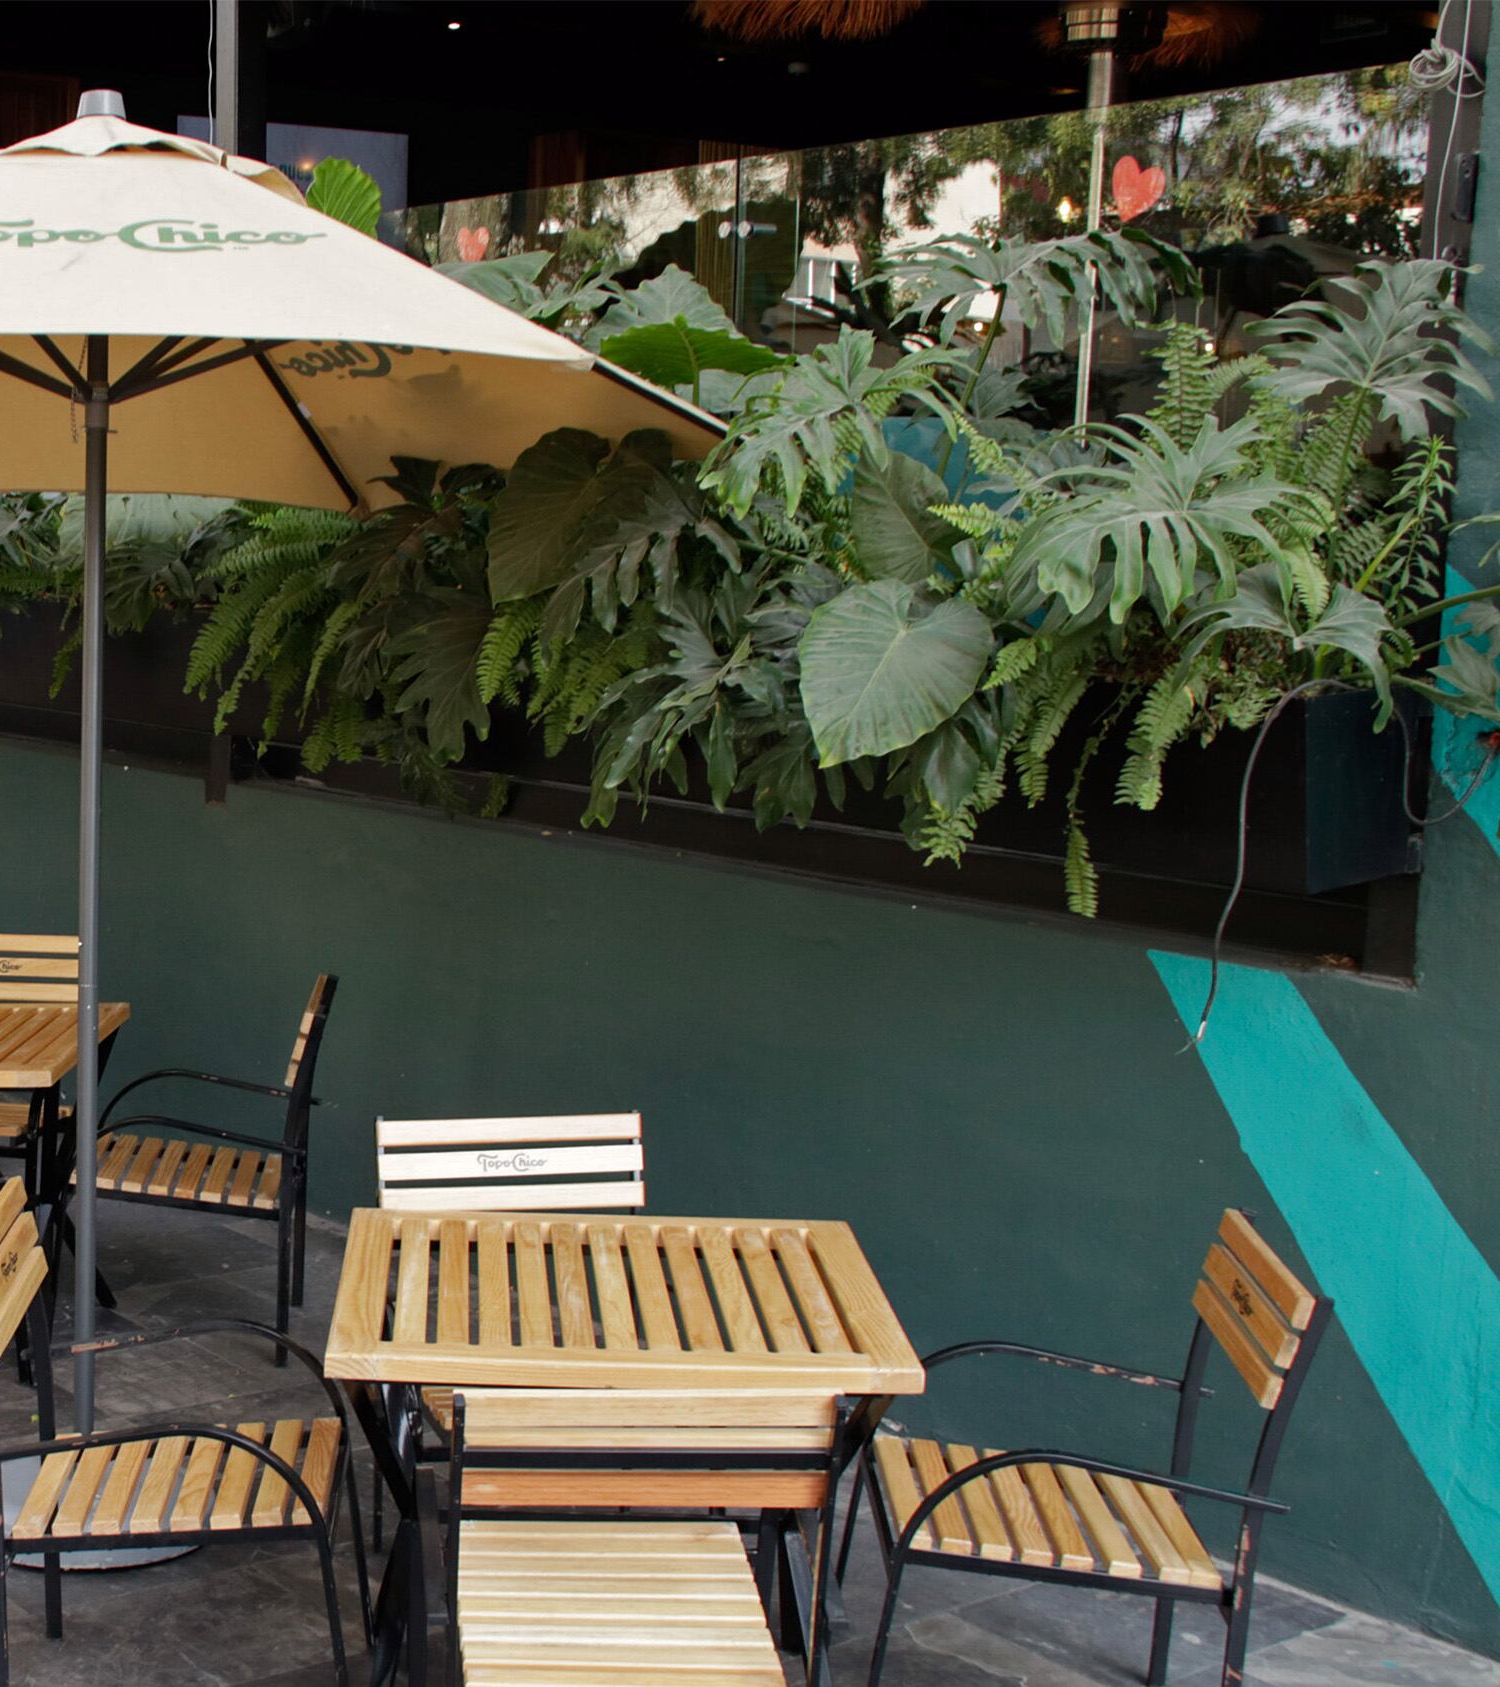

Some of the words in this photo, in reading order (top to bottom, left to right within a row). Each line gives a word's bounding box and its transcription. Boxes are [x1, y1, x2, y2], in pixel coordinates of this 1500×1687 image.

[112, 218, 328, 252] Chico
[476, 1153, 512, 1172] Topo
[512, 1152, 548, 1172] Chico
